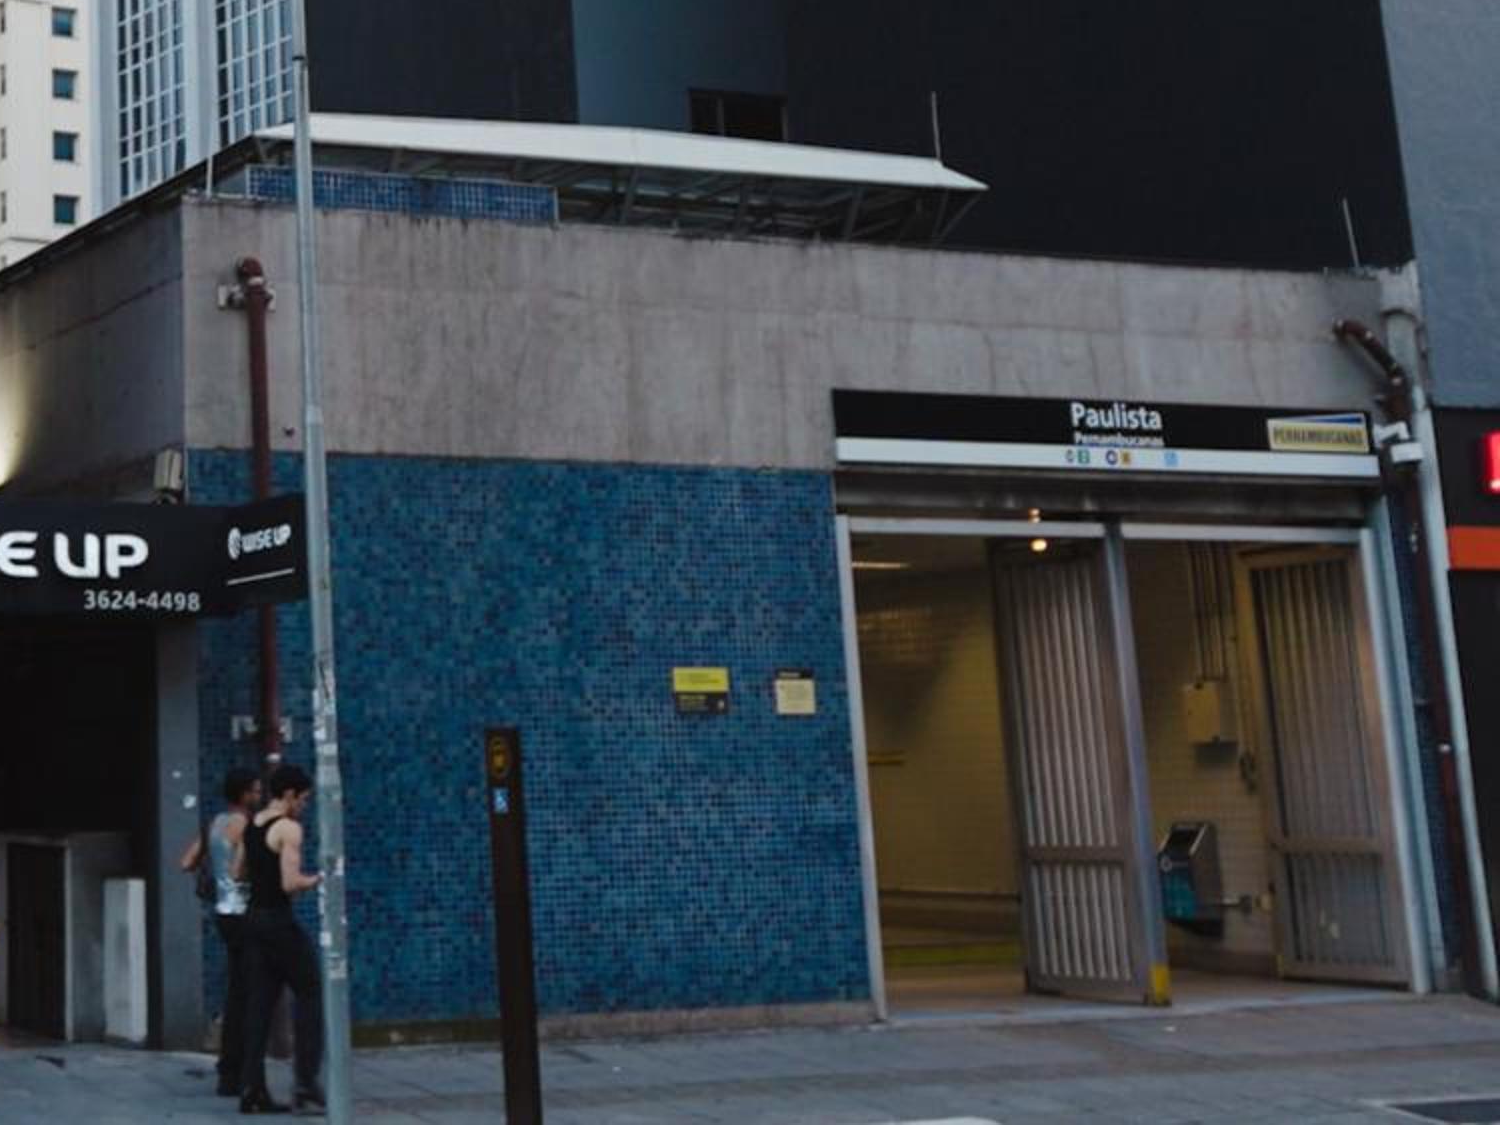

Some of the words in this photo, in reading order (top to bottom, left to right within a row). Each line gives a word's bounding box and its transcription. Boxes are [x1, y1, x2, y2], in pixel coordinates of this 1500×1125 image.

[1070, 401, 1163, 430] Paulista
[53, 531, 149, 579] UP
[83, 589, 201, 612] 3624-4498
